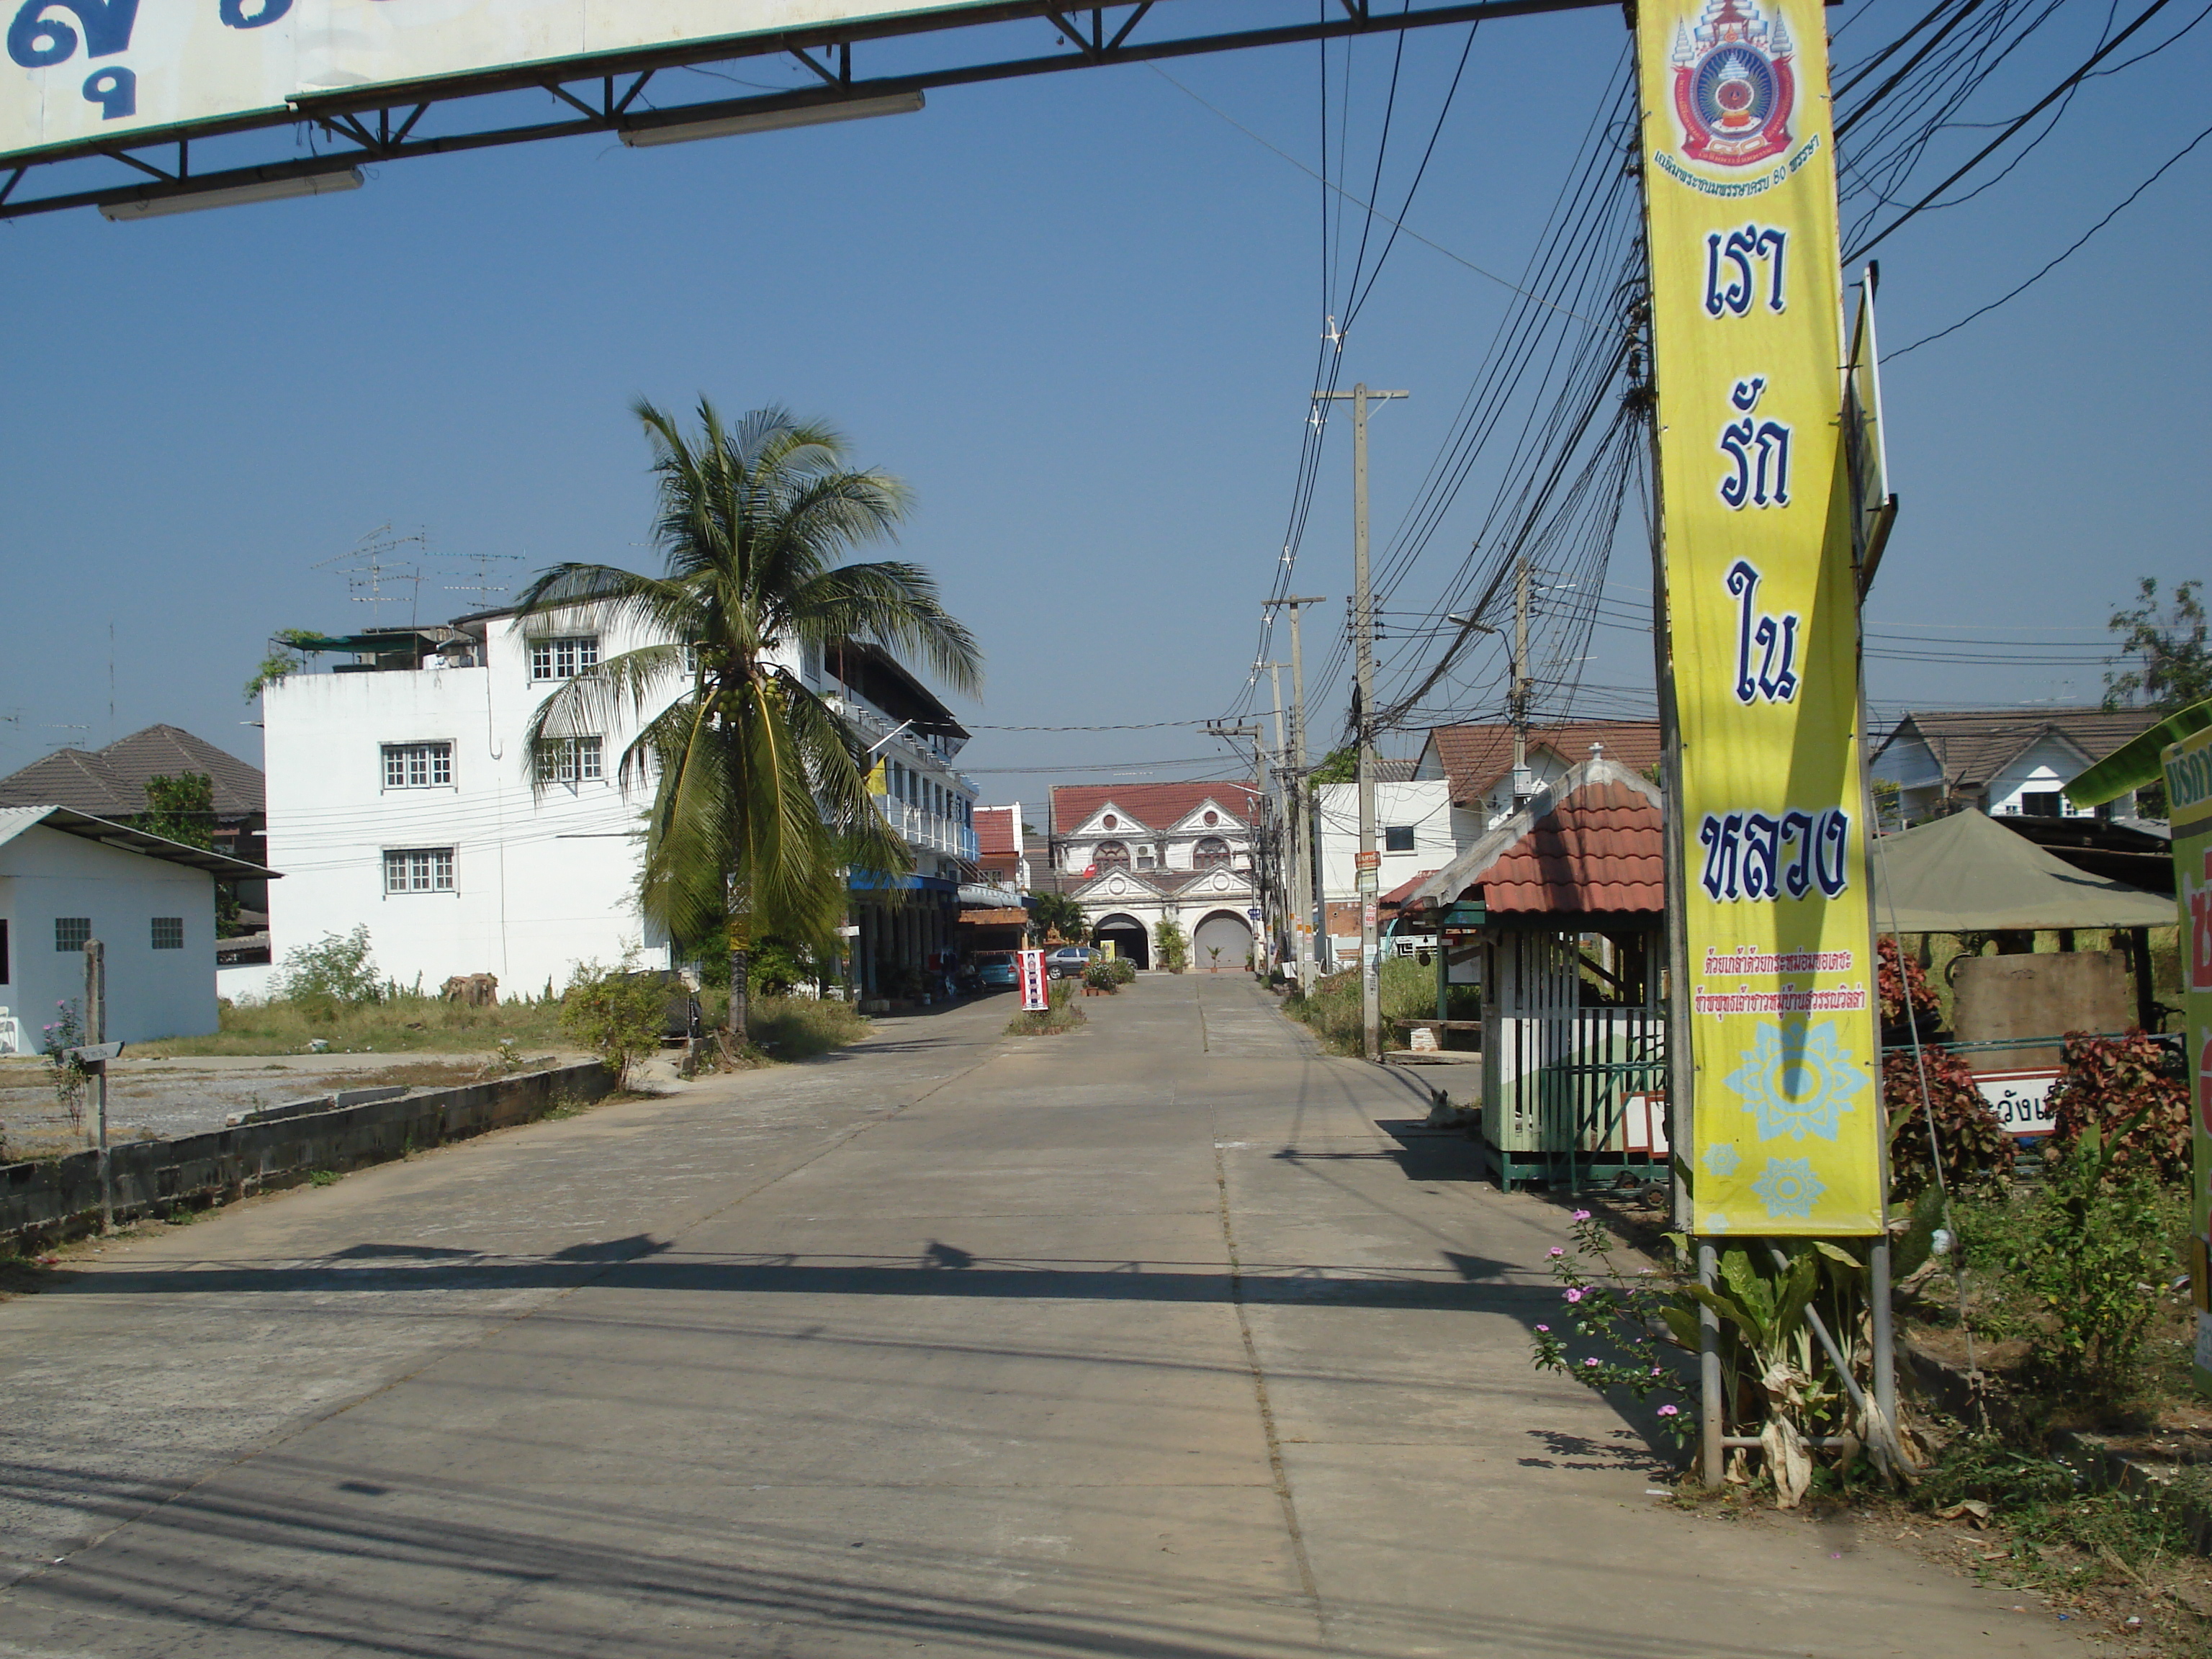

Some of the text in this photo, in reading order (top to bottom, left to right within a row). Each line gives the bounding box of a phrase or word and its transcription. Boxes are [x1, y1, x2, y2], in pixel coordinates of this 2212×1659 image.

[1773, 166, 1786, 185] 80
[1789, 134, 1820, 174] พรรษา
[1705, 223, 1786, 315] เรา
[1719, 377, 1791, 507] รัก
[1727, 560, 1798, 701] ใน
[1700, 809, 1848, 899] หลวง
